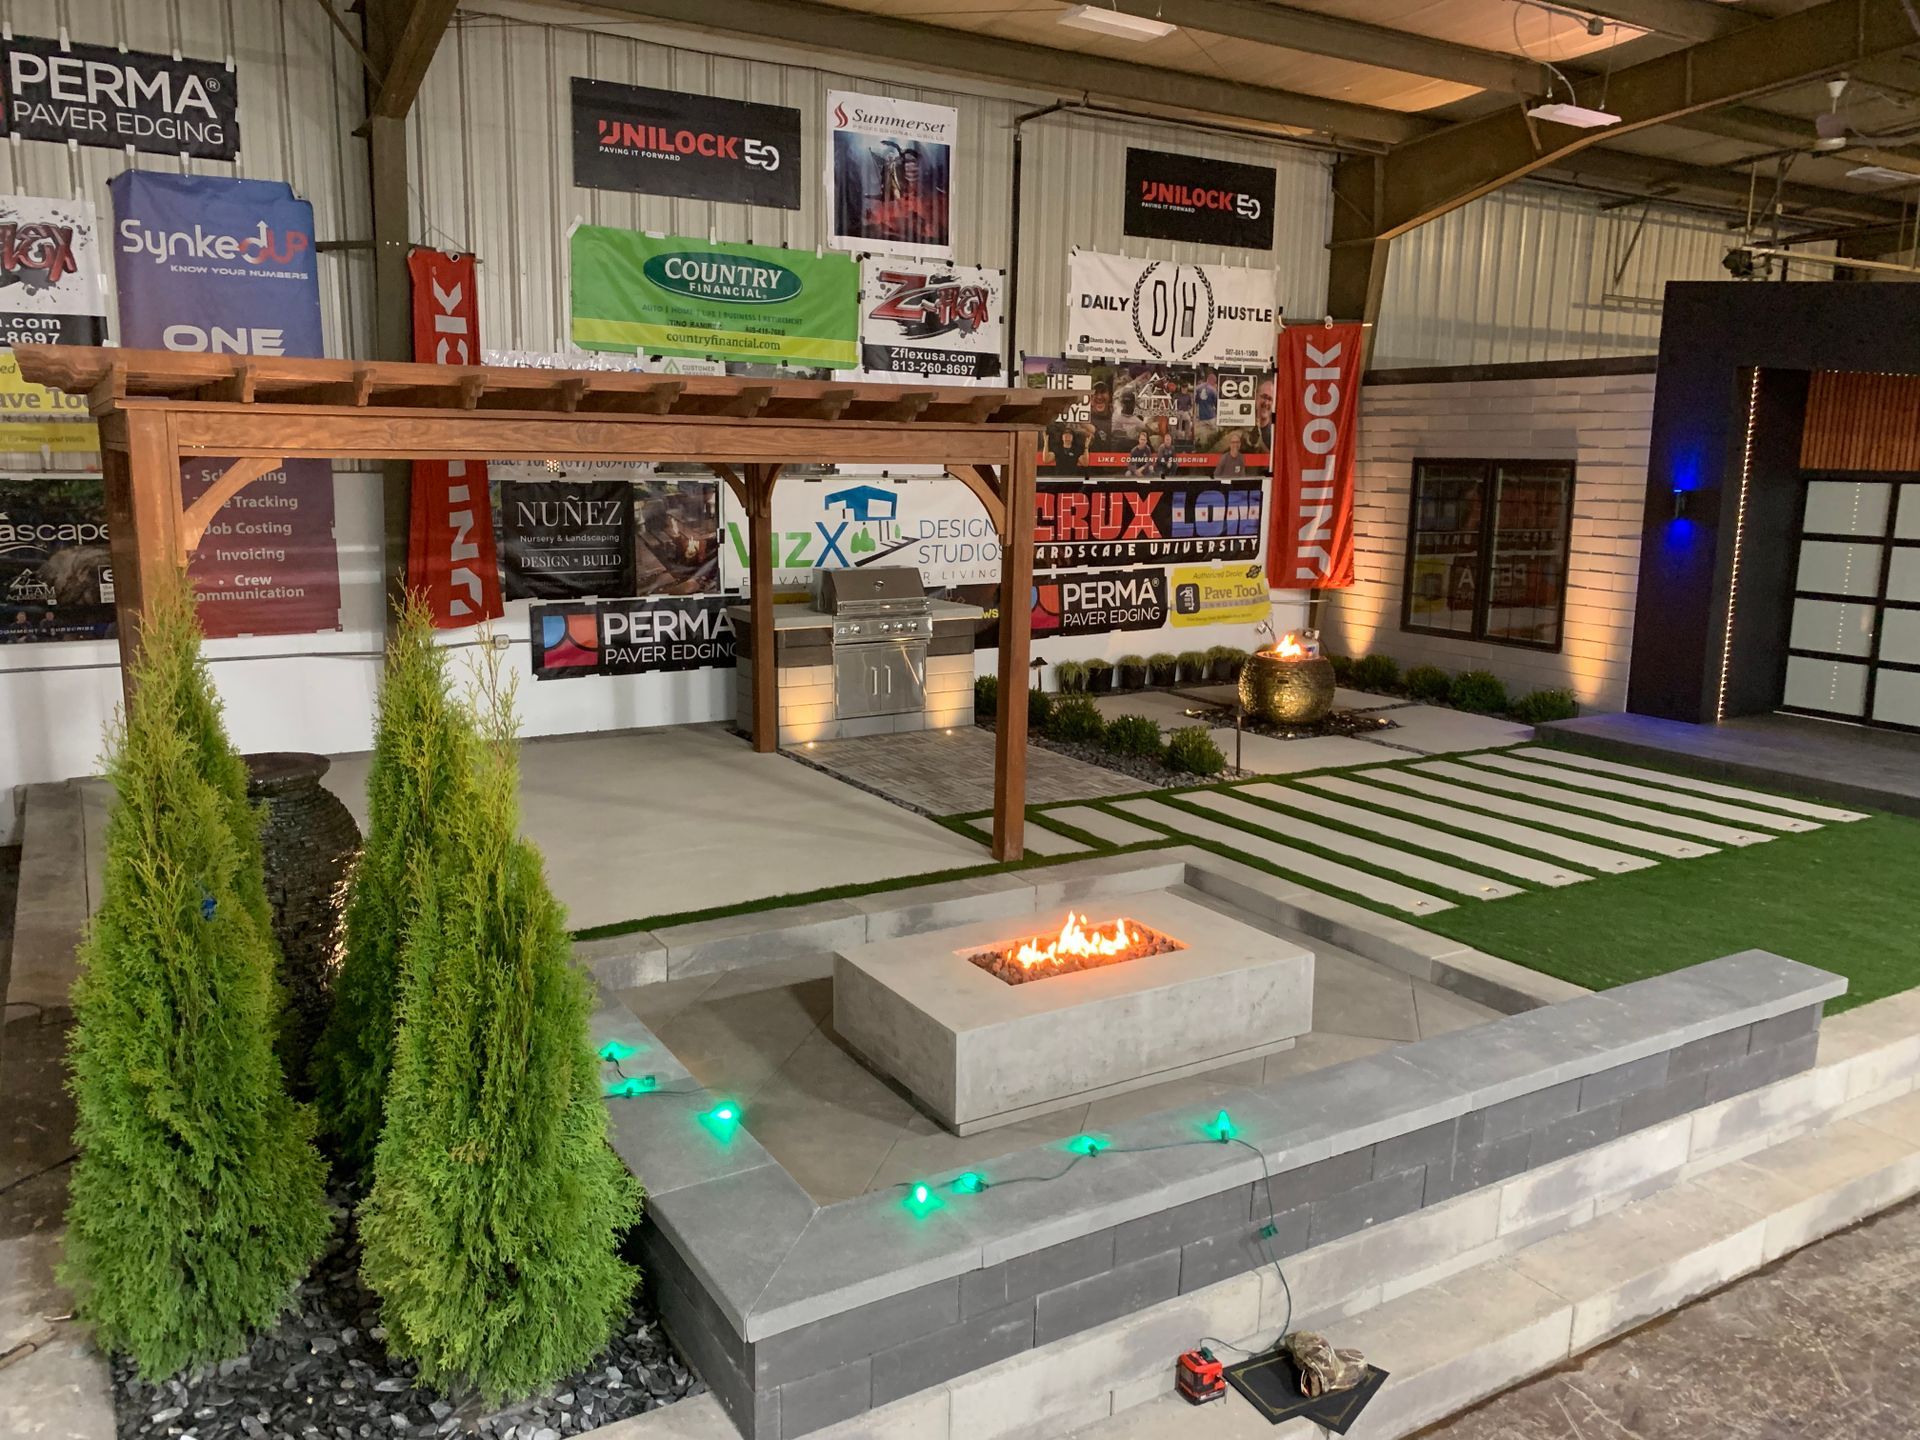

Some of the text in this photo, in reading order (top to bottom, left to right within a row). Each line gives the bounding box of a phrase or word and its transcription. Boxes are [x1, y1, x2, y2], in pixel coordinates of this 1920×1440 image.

[13, 100, 224, 144] PAVER EDGING
[852, 108, 946, 133] Summerset
[598, 119, 738, 160] UNILOCK
[599, 145, 629, 156] PAVING
[642, 151, 681, 161] FORWARD
[1142, 181, 1233, 211] UNILOCK
[170, 264, 309, 280] KNOW YOUR NUMBERS
[664, 257, 783, 289] COUNTRY
[689, 281, 763, 299] FINANCIAL
[642, 303, 663, 312] AUTO
[1081, 293, 1130, 312] DAILY
[1217, 305, 1273, 323] HUSTLE
[0, 317, 61, 330] .com
[163, 324, 286, 357] ONE
[666, 333, 781, 350] countryfinancial.com
[891, 347, 976, 363] Zflexusa.com
[682, 364, 716, 372] CUSTOMER
[892, 361, 975, 375] 813-260-8697
[1221, 375, 1254, 398] ed
[1296, 341, 1343, 580] UNILOCK
[233, 496, 298, 510] Tracking
[516, 494, 622, 527] NUÑEZ
[1033, 491, 1164, 542] CRUX
[235, 521, 292, 536] Costing
[520, 535, 554, 544] Nursery
[565, 533, 620, 543] Landscaping
[216, 548, 285, 562] Invoicing
[1036, 538, 1258, 560] ARDSCAPE UNIVERSITY
[521, 554, 622, 568] DESIGN BUILD
[234, 574, 272, 586] Crew
[942, 568, 998, 580] LIVING
[197, 586, 305, 602] ommunication
[1204, 582, 1263, 600] Pave Tool
[1063, 606, 1161, 628] PAVER EDGING
[603, 608, 736, 645] PERMA
[605, 646, 666, 665] PAVER
